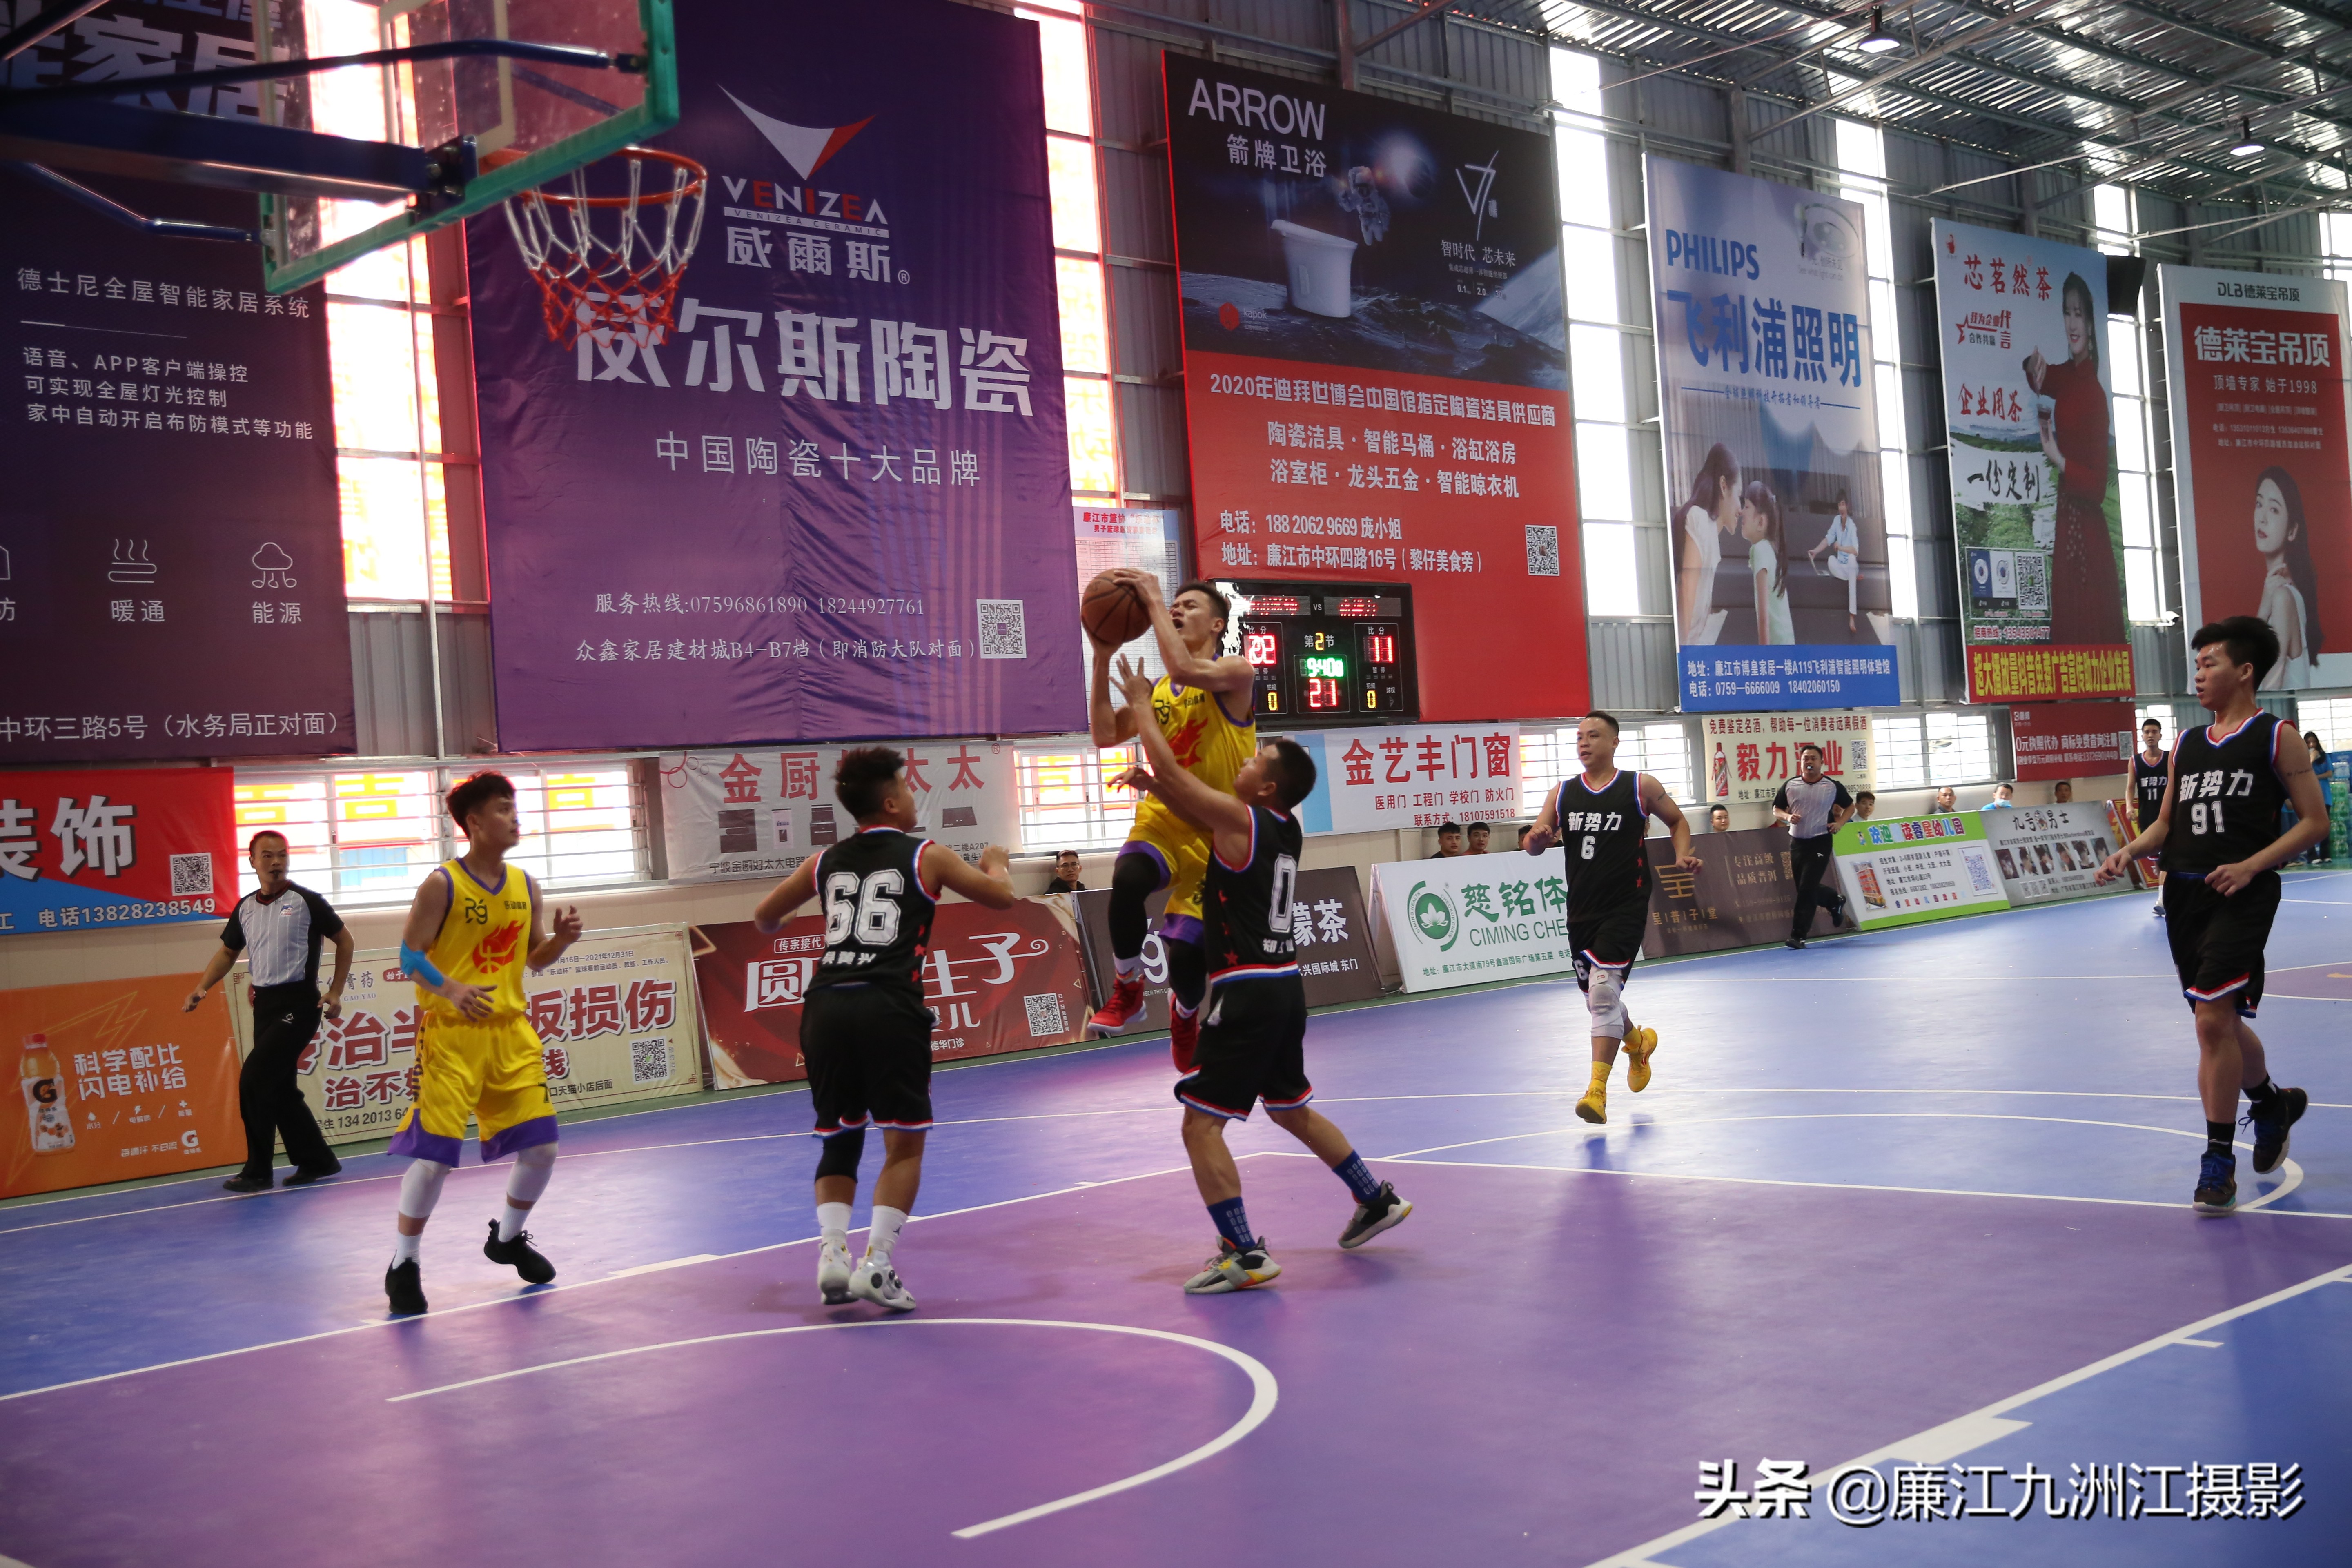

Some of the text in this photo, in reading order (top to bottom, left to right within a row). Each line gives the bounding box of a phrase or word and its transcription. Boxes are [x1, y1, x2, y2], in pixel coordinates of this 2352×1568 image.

[1188, 78, 1326, 140] ARROW
[1227, 134, 1327, 178] 箭牌卫浴
[722, 175, 888, 225] VENIZEA
[735, 209, 883, 237] VENIZEA CERAMIC
[1441, 239, 1516, 267] 智时代 芯未来
[1666, 229, 1759, 280] PHILIPS
[1964, 254, 2052, 301] 芯茗然茶
[18, 267, 310, 318] 德士尼全屋智能家居系统
[2218, 282, 2300, 302] DLB 德莱宝吊顶
[1244, 308, 1267, 320] kapok
[1667, 289, 1862, 388] 飞利浦照明
[2194, 325, 2330, 368] 德莱宝吊顶
[575, 290, 1035, 418] 威尔斯陶瓷
[25, 375, 227, 408] 可实现全屋灯光控制
[2213, 374, 2318, 394] 顶墙专家 始于1998
[1209, 374, 1556, 427] 2020年迪拜世博会中国馆指定陶瓷洁具供应商
[1958, 383, 2022, 423] 企业用茶
[27, 403, 313, 440] 家中自动开启布防模式等功能
[656, 431, 980, 487] 中国陶瓷十大品牌
[1967, 458, 2040, 502] 一份定制
[1220, 510, 1403, 540] 电话： 188 2062 9669 庞小姐
[1222, 543, 1482, 574] 地址： 廉江市中环四路16号（黎仔美食旁）
[110, 599, 165, 623] 暖通
[252, 601, 302, 625] 能源
[818, 596, 924, 617] 18244927761
[1248, 626, 1267, 635] 比分
[1368, 626, 1385, 635] 比分
[1687, 659, 1891, 677] 地址： 廉江市博皇家居一楼A119飞利浦智能照明体验馆
[1267, 692, 1278, 710] 0
[1309, 678, 1338, 708] 21
[1366, 690, 1376, 708] 0
[1689, 681, 1711, 697] 电话：
[1788, 680, 1840, 693] 18402060150
[0, 712, 339, 742] 中环三路5号（水务局正对面）
[1709, 716, 1868, 735] 免费鉴定名酒，帮助每一位消费者远离假酒
[1342, 732, 1511, 786] 金艺丰门窗
[719, 746, 985, 804] 金厨太太
[2140, 776, 2167, 787] 新势力
[2179, 769, 2254, 802] 新势力
[1375, 787, 1514, 811] 医用门 工程门 学校门 防火门
[2147, 789, 2158, 800] 11
[1414, 808, 1515, 827] 联系方式： 18107591518
[1568, 812, 1622, 832] 新势力
[2191, 800, 2225, 835] 91
[1581, 835, 1595, 860] 6
[1734, 852, 1774, 867] 专注高级
[1737, 870, 1777, 886] 品质普洱
[1269, 853, 1298, 933] 0
[38, 898, 216, 929] 电话13828238549
[824, 869, 904, 946] 66
[779, 936, 822, 951] 传宗接代
[1470, 923, 1529, 947] CIMING
[1340, 958, 1359, 971] 东门
[1422, 967, 1440, 976] 地址：
[1442, 951, 1554, 974] 廉江市大道南79号鑫源国际广场第五层
[1573, 960, 1589, 980] 6
[344, 993, 359, 1002] GAO
[74, 1043, 183, 1076] 科学配比
[33, 1078, 58, 1103] G
[78, 1067, 187, 1101] 闪电补给
[86, 1121, 102, 1130] 水分
[338, 1114, 360, 1128] 134
[362, 1111, 392, 1125] 2013
[181, 1129, 199, 1148] G
